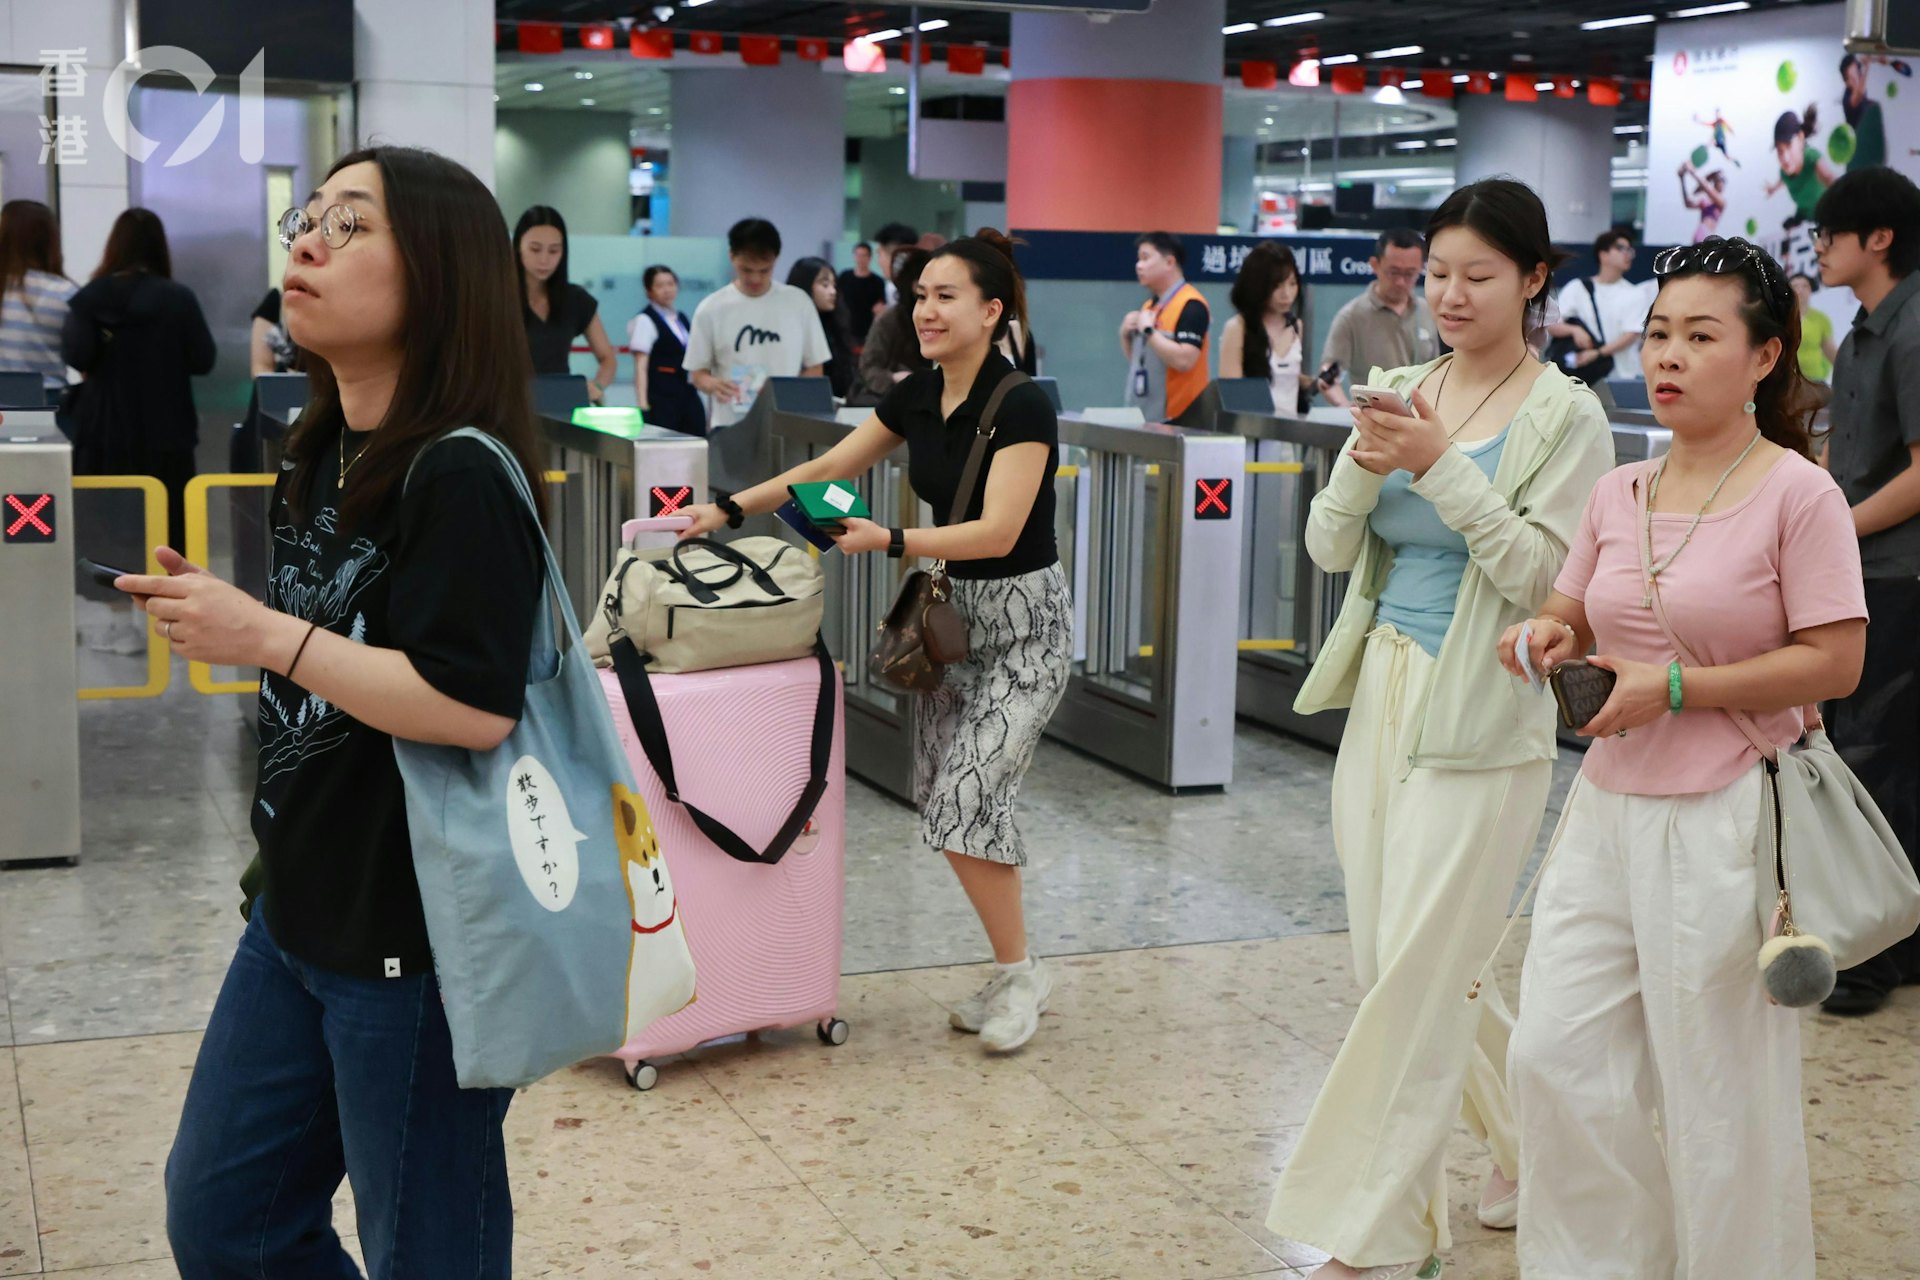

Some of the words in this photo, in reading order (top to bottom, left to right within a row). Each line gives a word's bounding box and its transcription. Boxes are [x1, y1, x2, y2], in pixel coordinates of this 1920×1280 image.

[516, 773, 558, 898] 散歩ですか?
